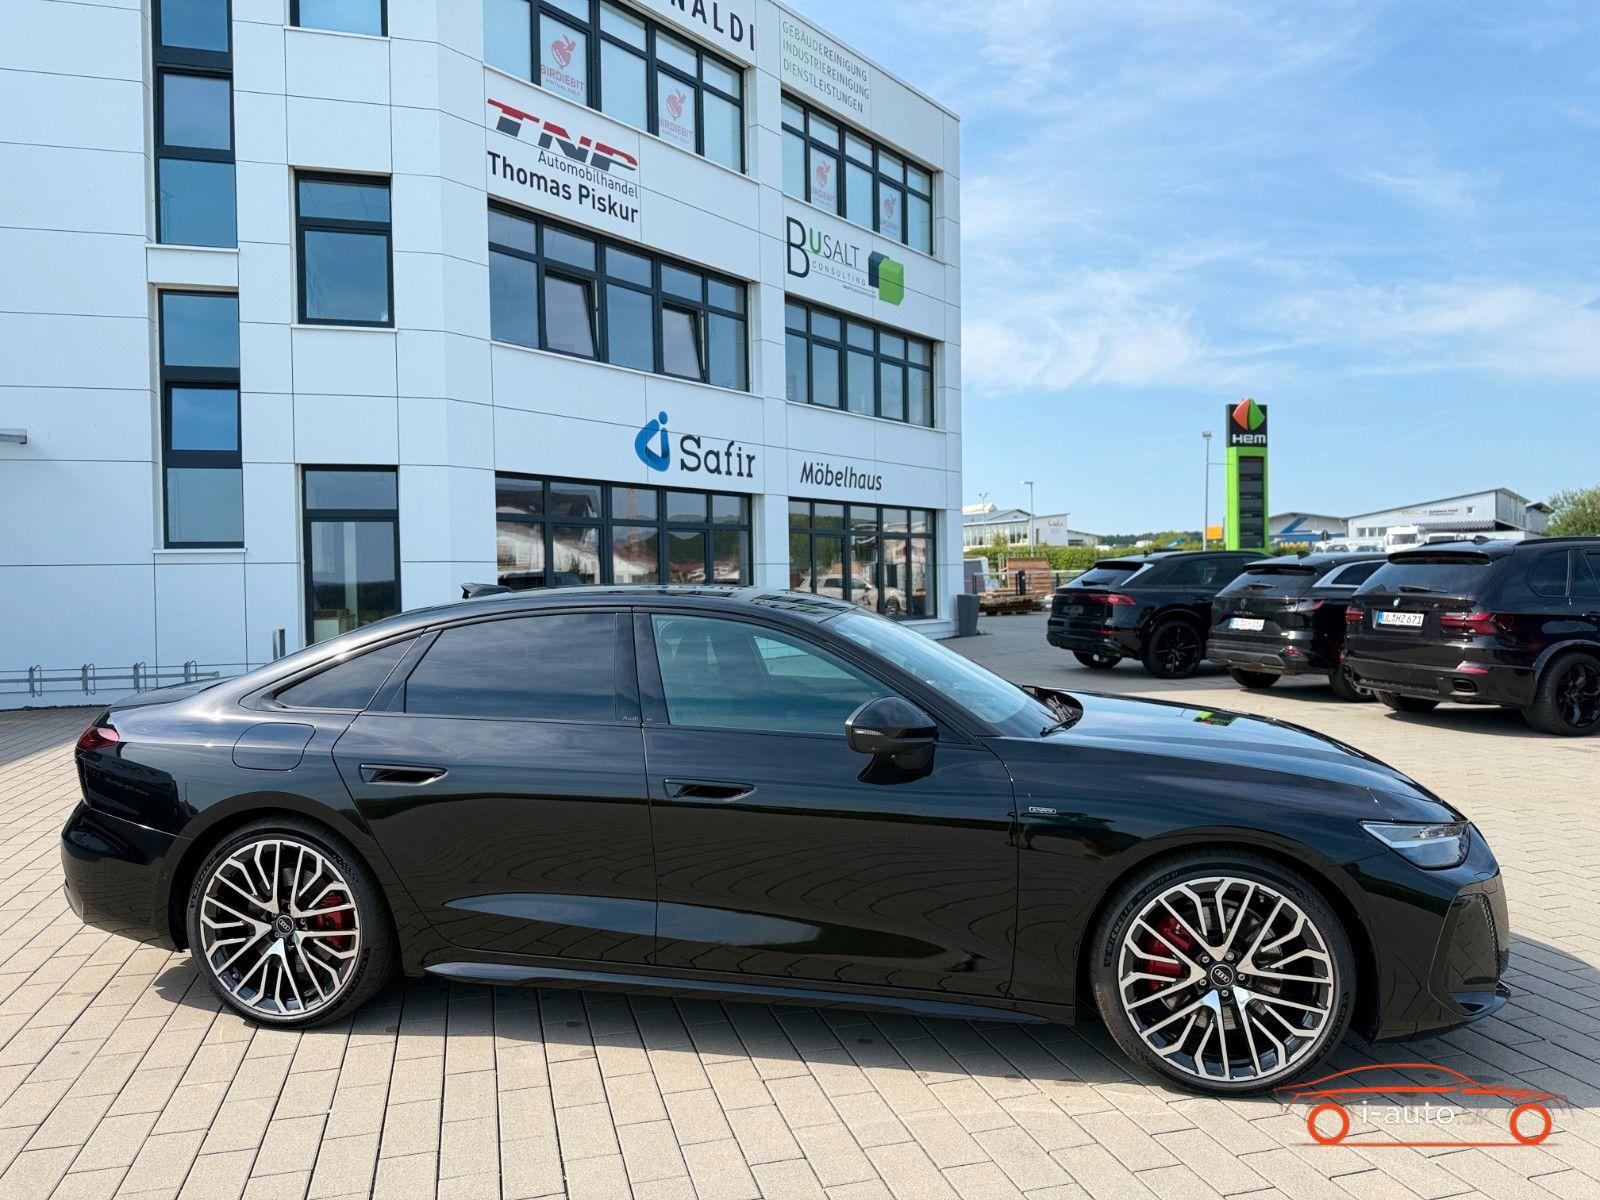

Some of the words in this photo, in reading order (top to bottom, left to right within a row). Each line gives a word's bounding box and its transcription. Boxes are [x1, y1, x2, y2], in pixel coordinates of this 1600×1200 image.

[540, 64, 585, 91] BIRDIEBIT
[782, 21, 868, 82] GEBÄUDEREINIGUNG
[782, 38, 870, 100] INDUSTRIEREINIGUNG
[782, 59, 863, 113] DIENSTLEISTUNGEN
[487, 98, 638, 172] TNP
[487, 150, 573, 202] Thomas
[578, 183, 639, 223] Piskur
[538, 150, 639, 199] Automobilhandel
[786, 216, 860, 278] BUSALT
[812, 260, 867, 287] CONSULTING
[680, 434, 756, 478] Safir
[800, 461, 882, 491] Möbelhaus
